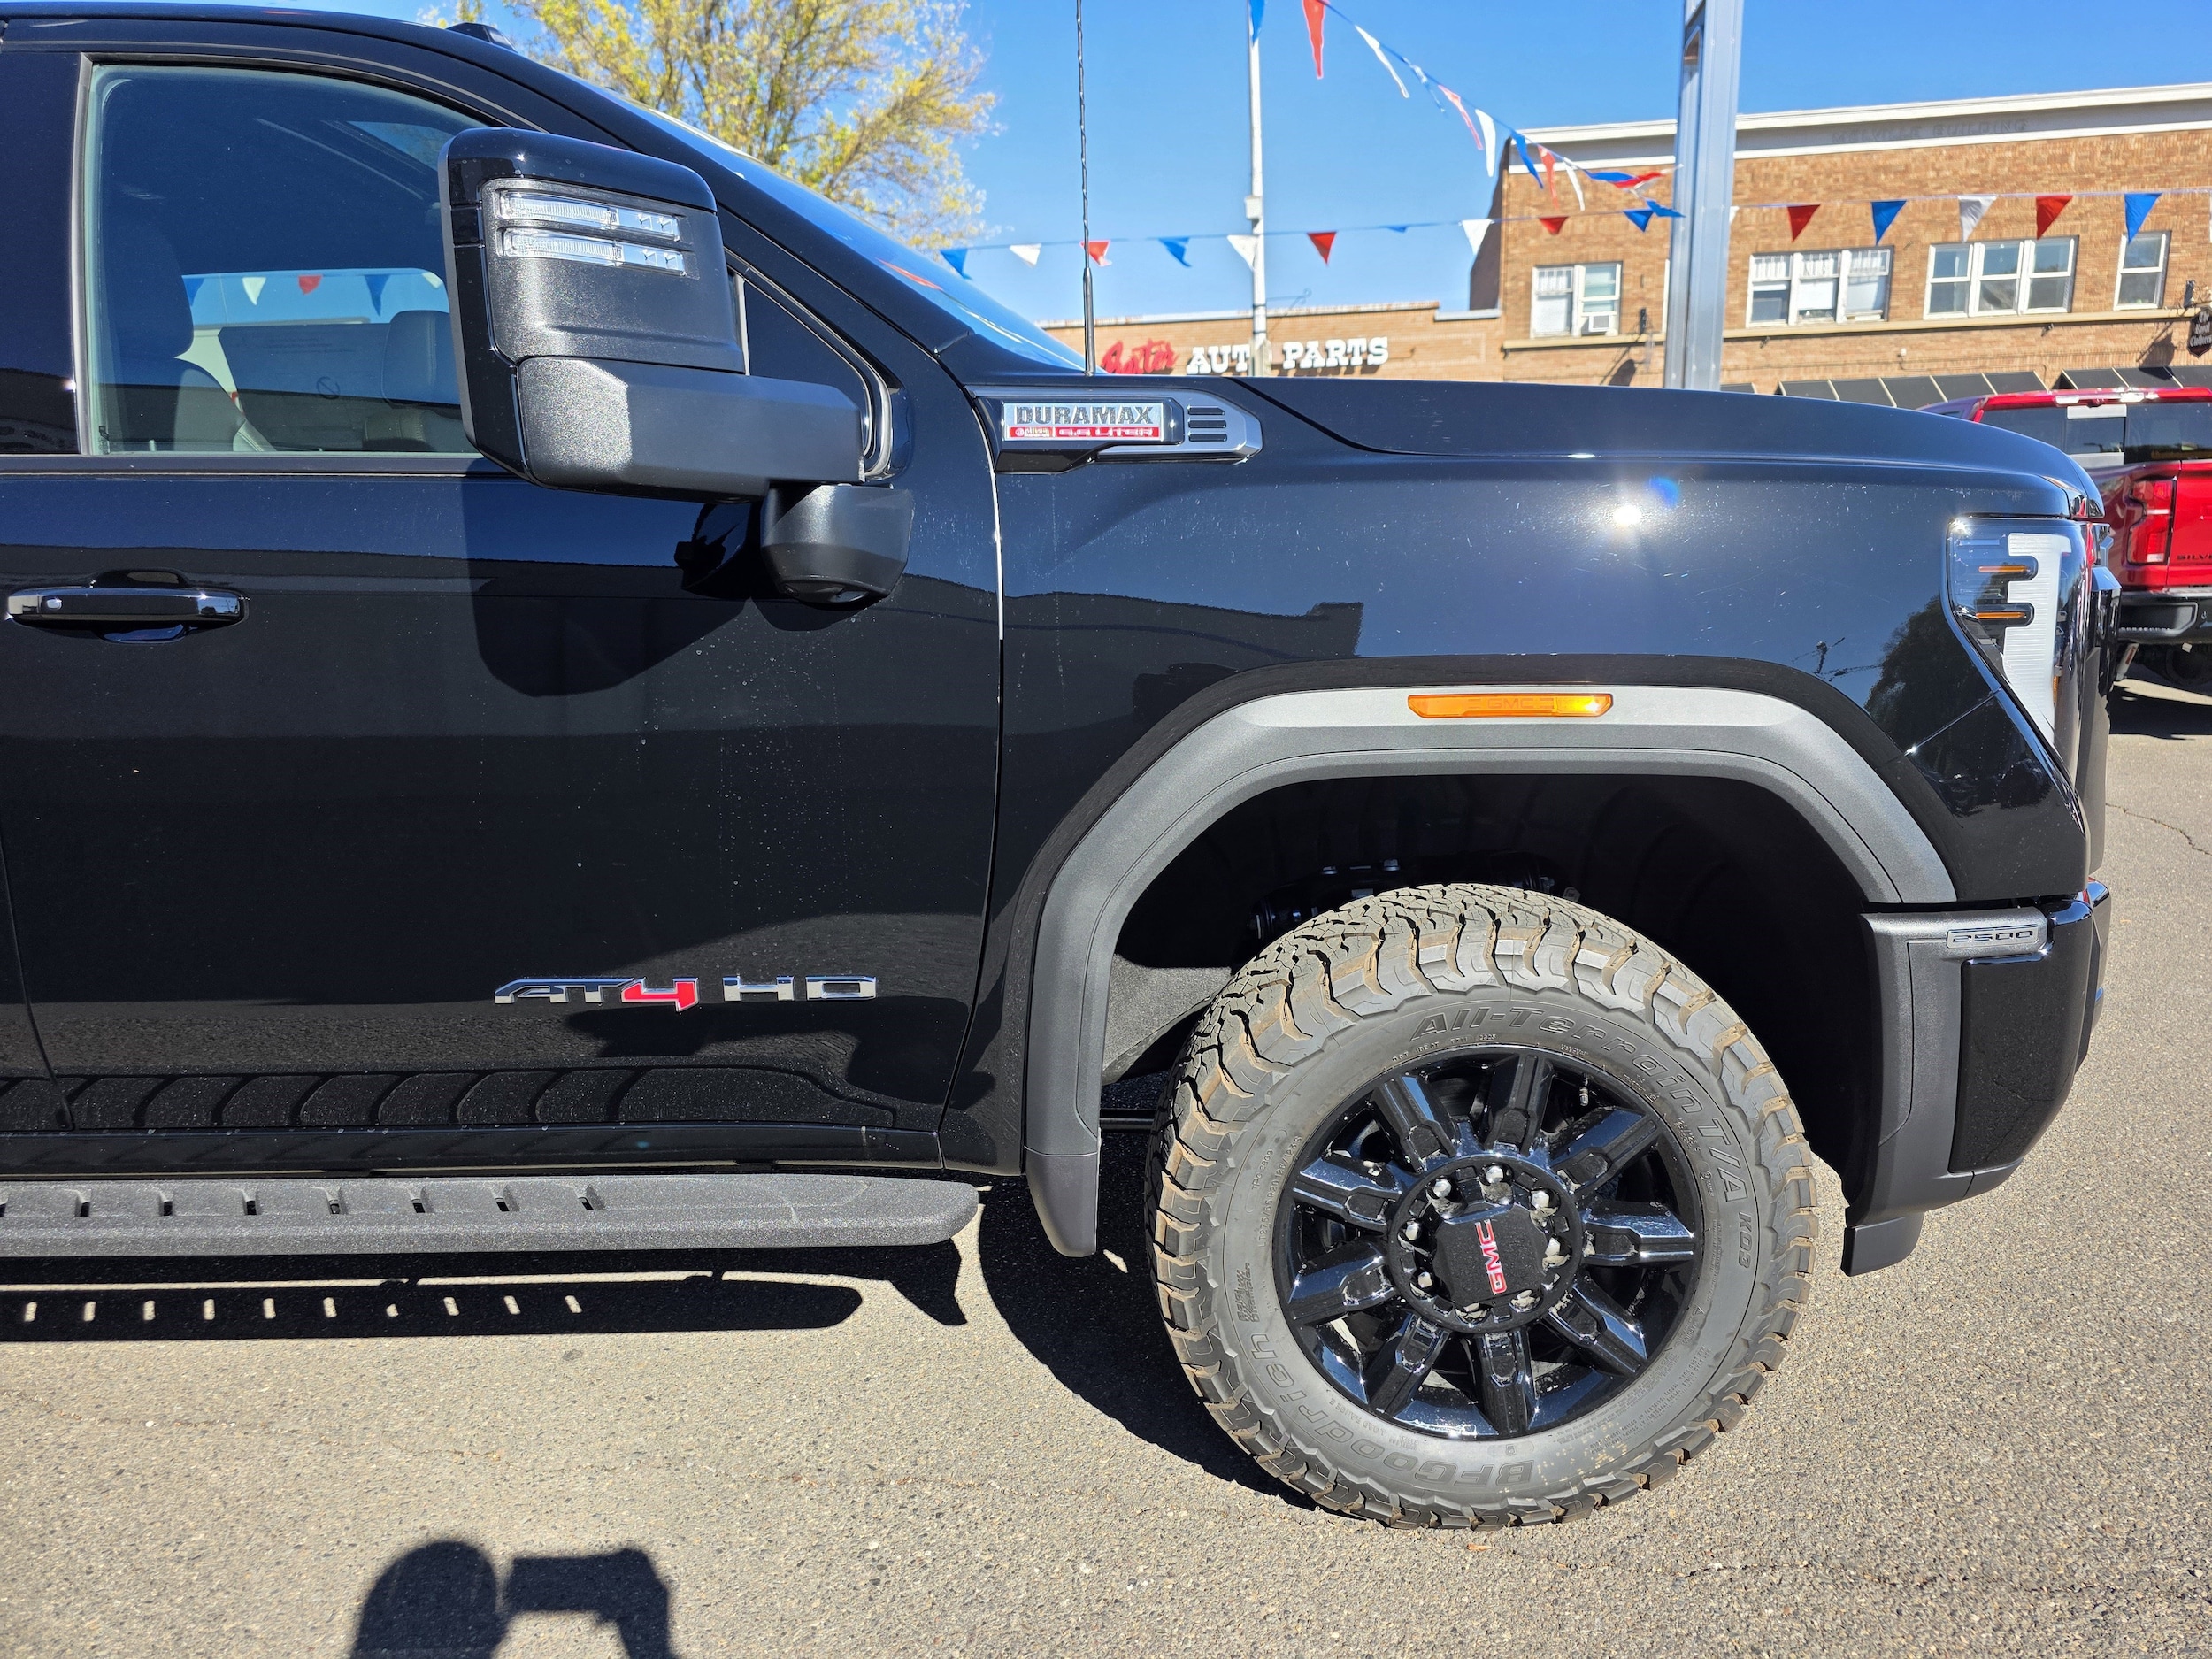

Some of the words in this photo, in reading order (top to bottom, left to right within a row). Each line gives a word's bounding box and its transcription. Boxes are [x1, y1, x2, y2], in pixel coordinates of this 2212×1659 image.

[1932, 119, 2029, 138] BUILDING
[1283, 336, 1389, 370] PARTS
[1013, 405, 1154, 425] DURAMAX
[1952, 930, 2033, 943] 2500
[494, 976, 699, 1012] AT4
[722, 976, 878, 1002] HD
[1409, 1006, 1703, 1114] All-Terrain
[1697, 1118, 1748, 1202] T/A
[1474, 1218, 1508, 1296] GMC
[1249, 1333, 1535, 1486] BFGoodrich
